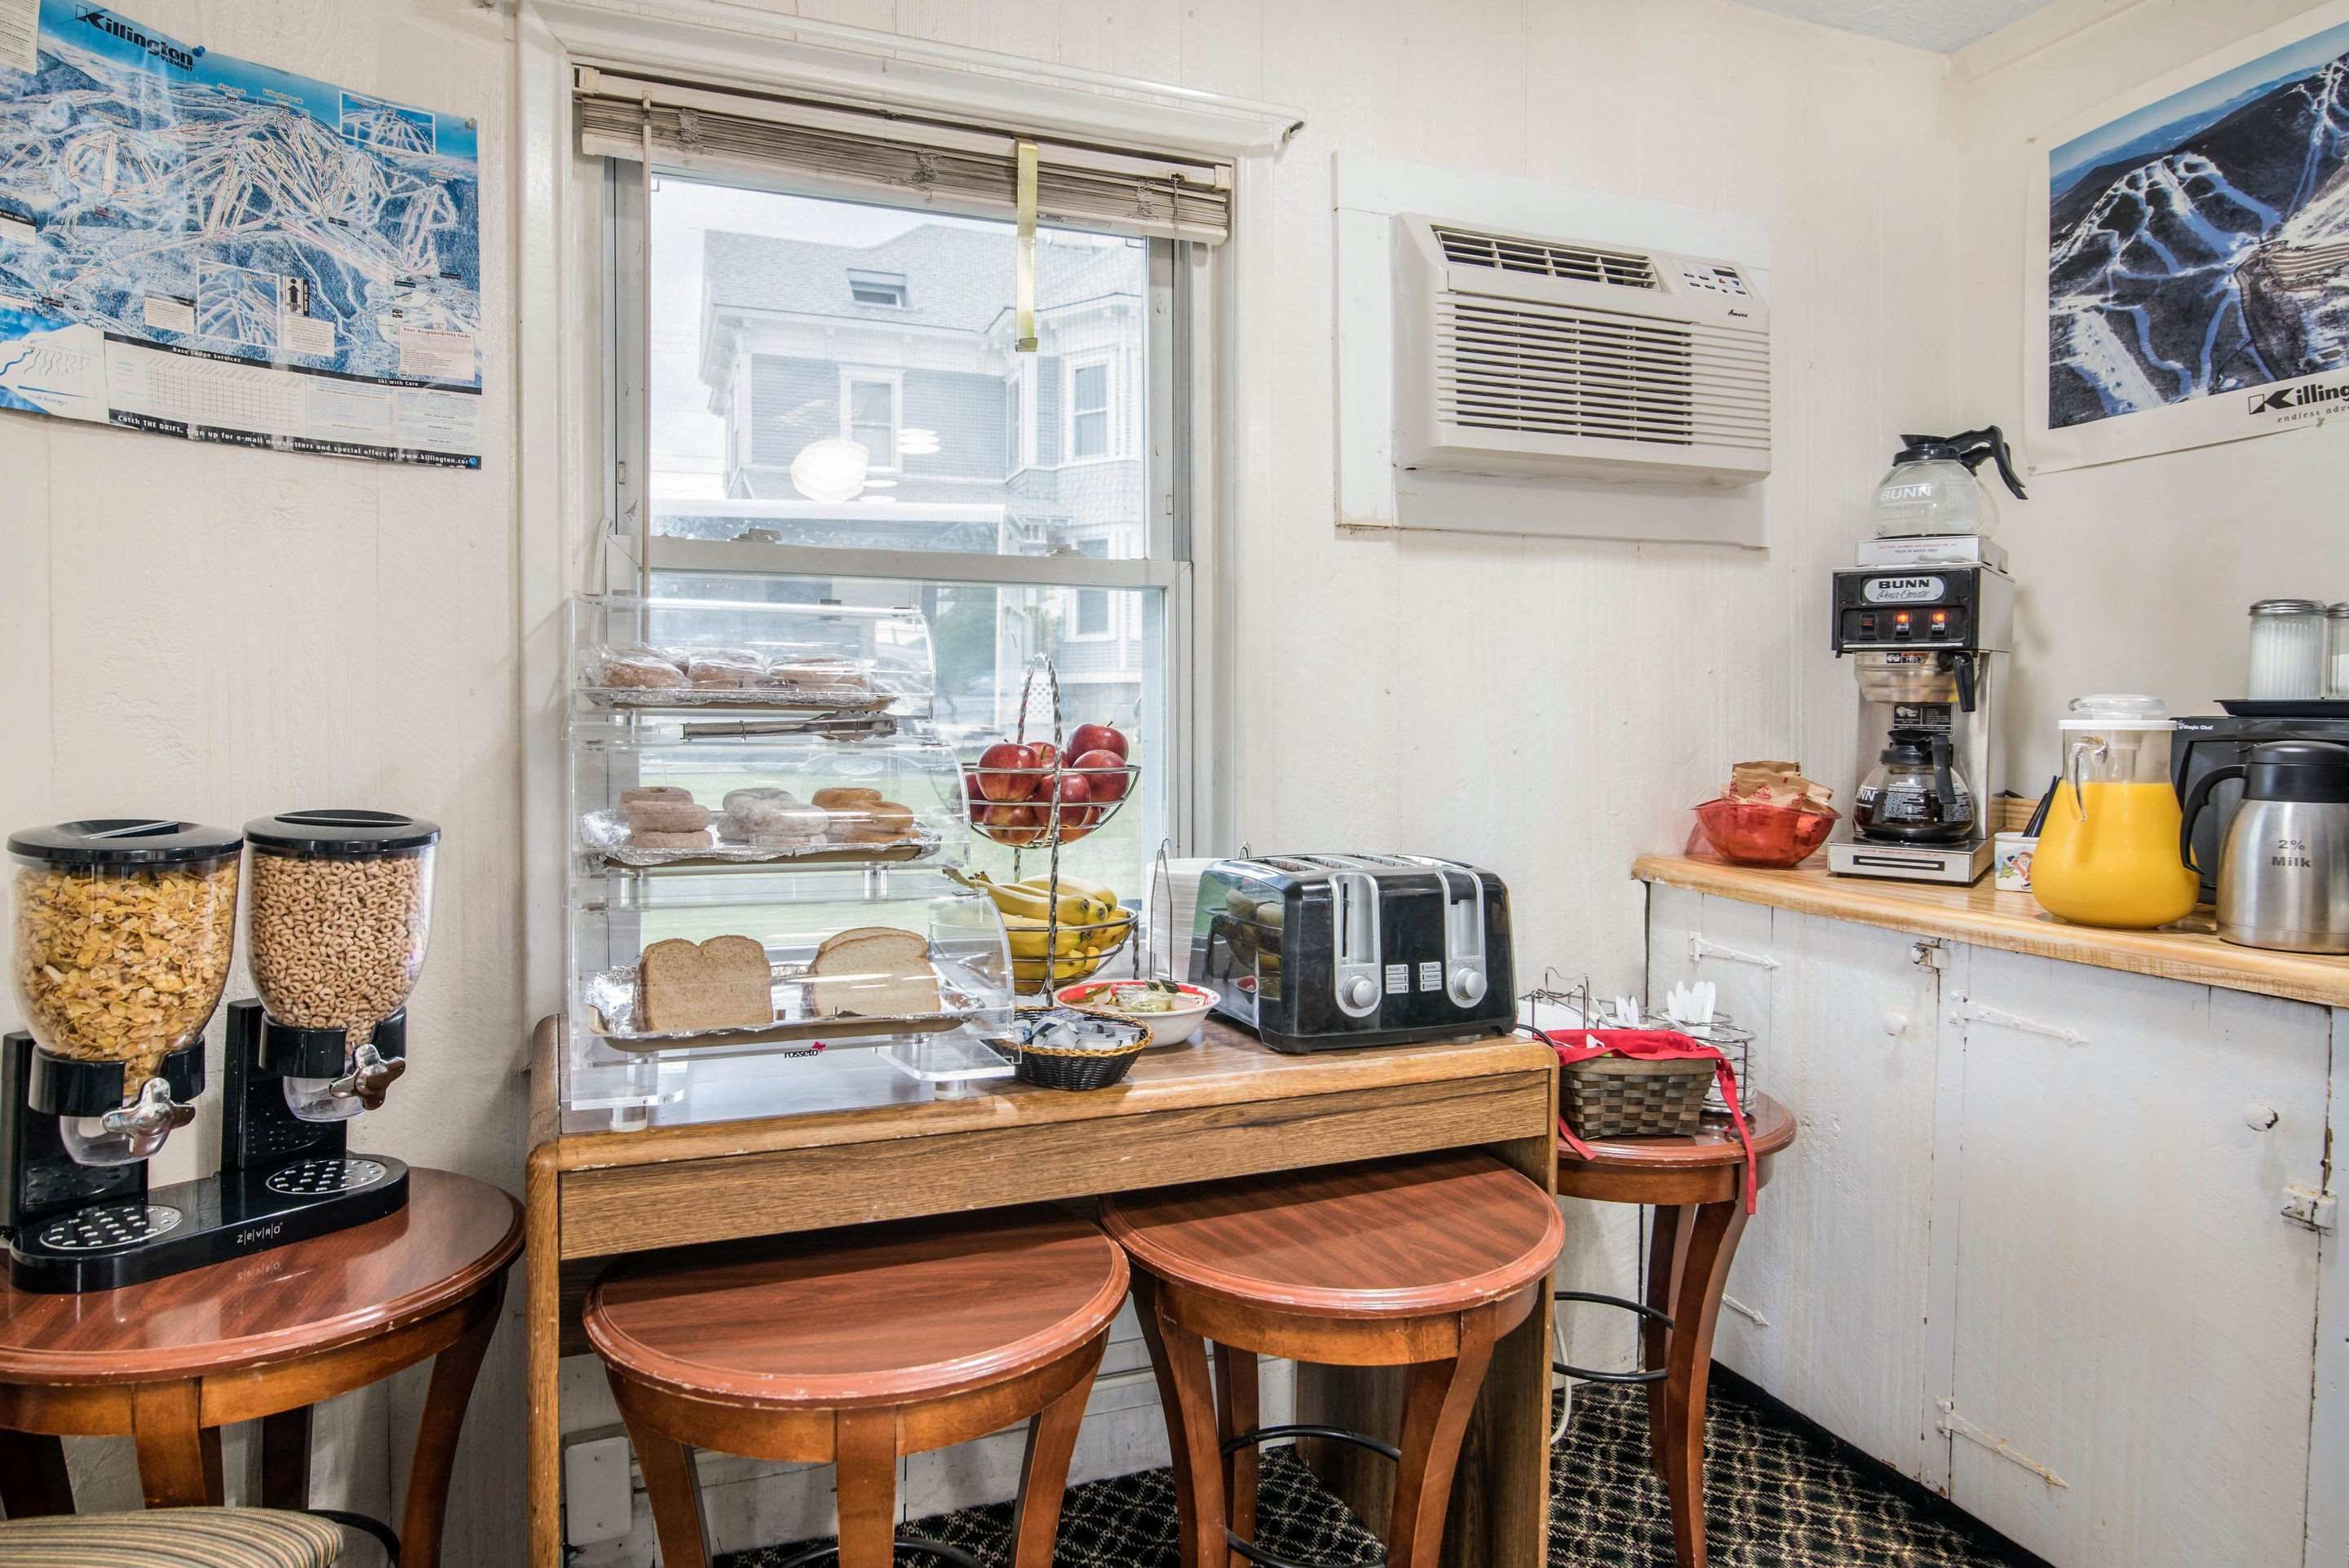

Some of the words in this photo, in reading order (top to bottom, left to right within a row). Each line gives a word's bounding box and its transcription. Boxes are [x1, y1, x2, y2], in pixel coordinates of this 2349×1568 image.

[77, 7, 194, 67] Killington
[1727, 309, 1748, 318] Amana
[213, 353, 241, 364] Services
[2277, 410, 2320, 423] endless
[117, 414, 140, 425] Catch
[143, 419, 157, 428] THE
[186, 428, 204, 438] Sgn
[237, 435, 263, 444] e-mail
[316, 443, 331, 451] and
[334, 444, 361, 454] special
[364, 448, 387, 457] offers
[1879, 485, 1932, 501] BUNN
[1878, 579, 1930, 589] BUNN
[2278, 839, 2306, 850] 2%
[2272, 856, 2311, 868] Milk
[784, 1049, 819, 1058] rosseto
